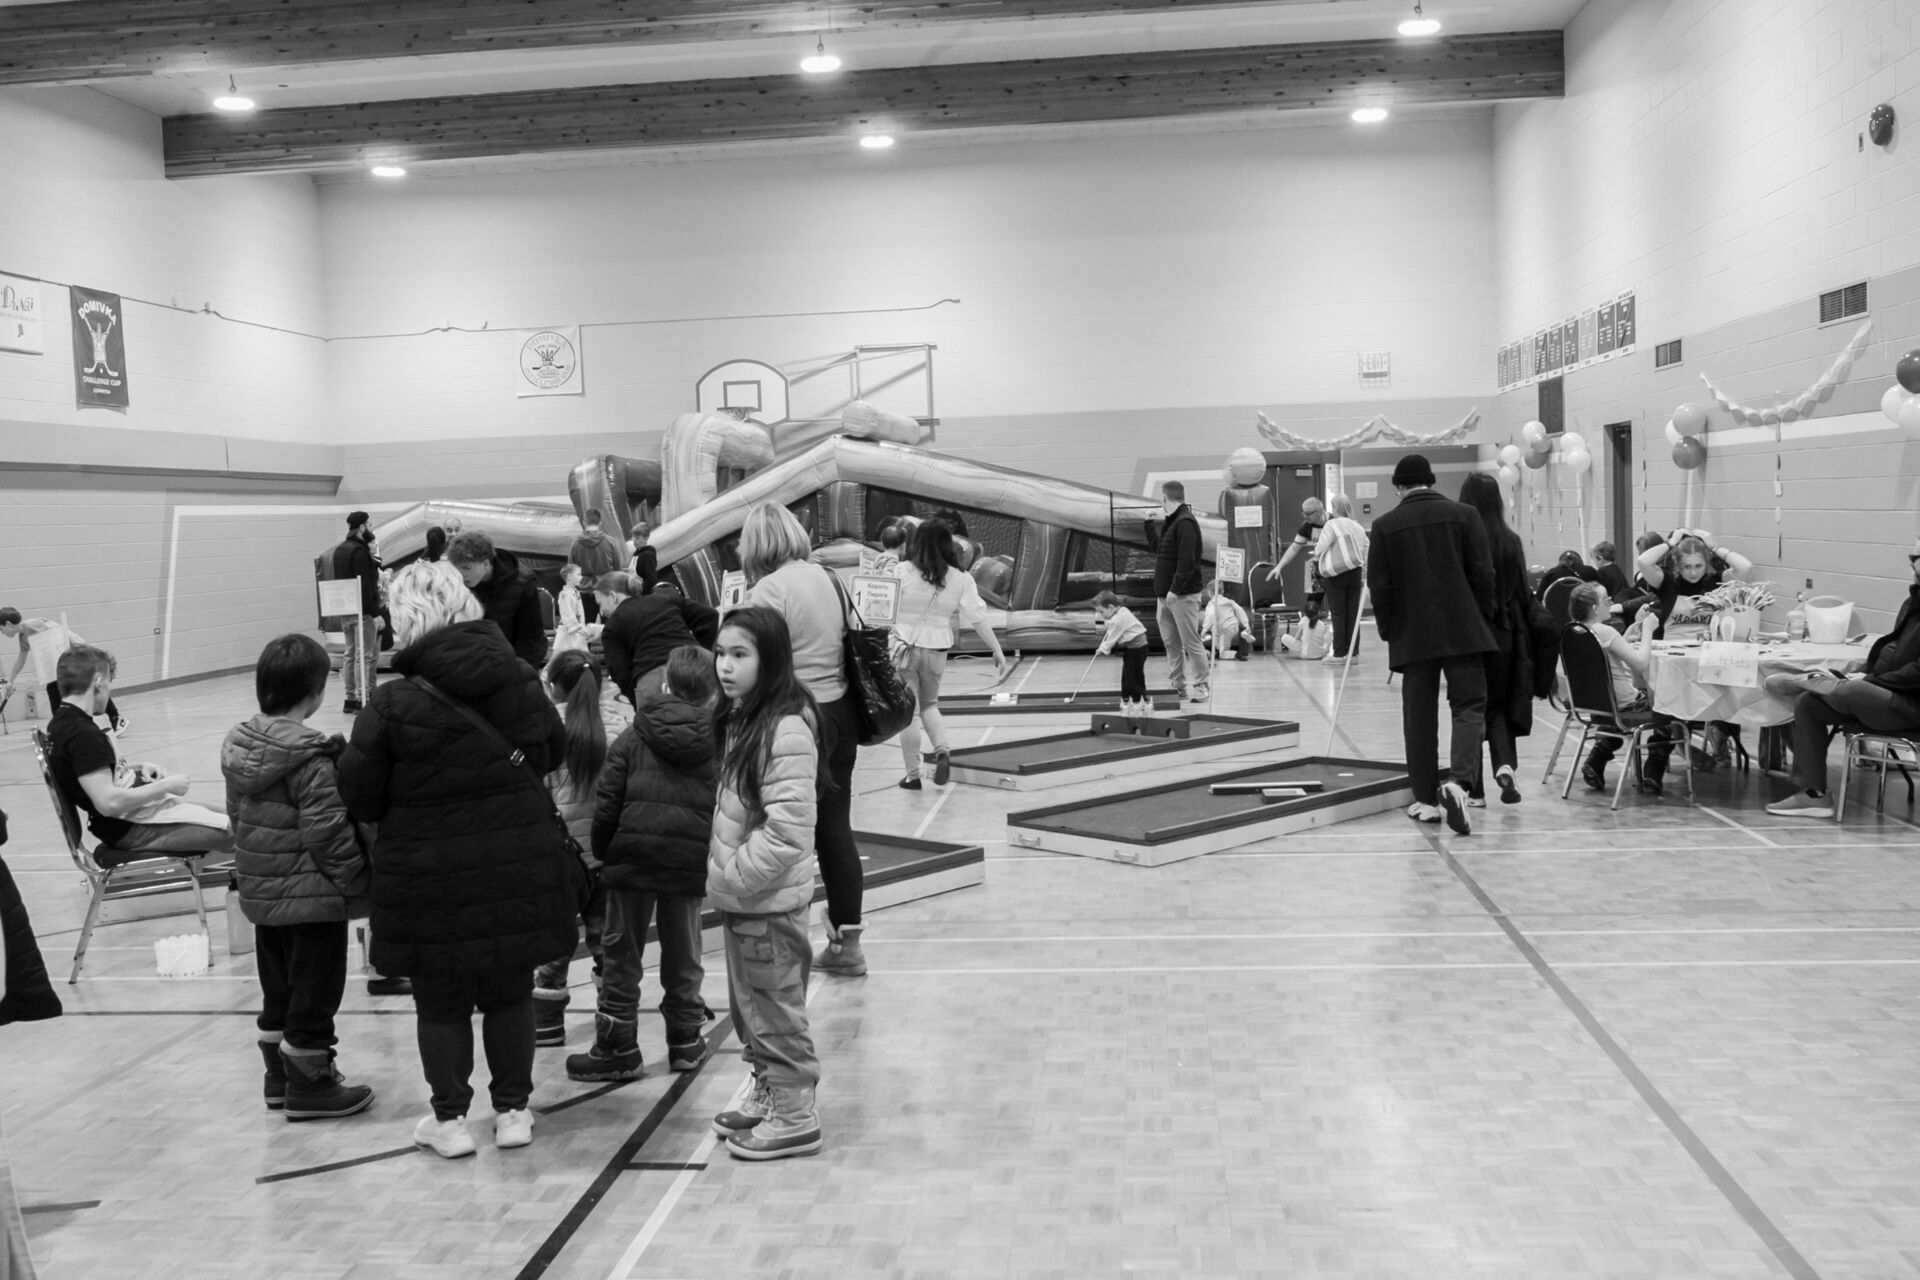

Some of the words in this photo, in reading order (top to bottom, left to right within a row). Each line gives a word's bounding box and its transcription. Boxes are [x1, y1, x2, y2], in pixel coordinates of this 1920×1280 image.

[77, 300, 117, 326] DOMIVKA
[82, 375, 110, 386] CHALLENGE
[1220, 557, 1225, 569] 3
[725, 585, 731, 599] 6
[856, 590, 862, 607] 1
